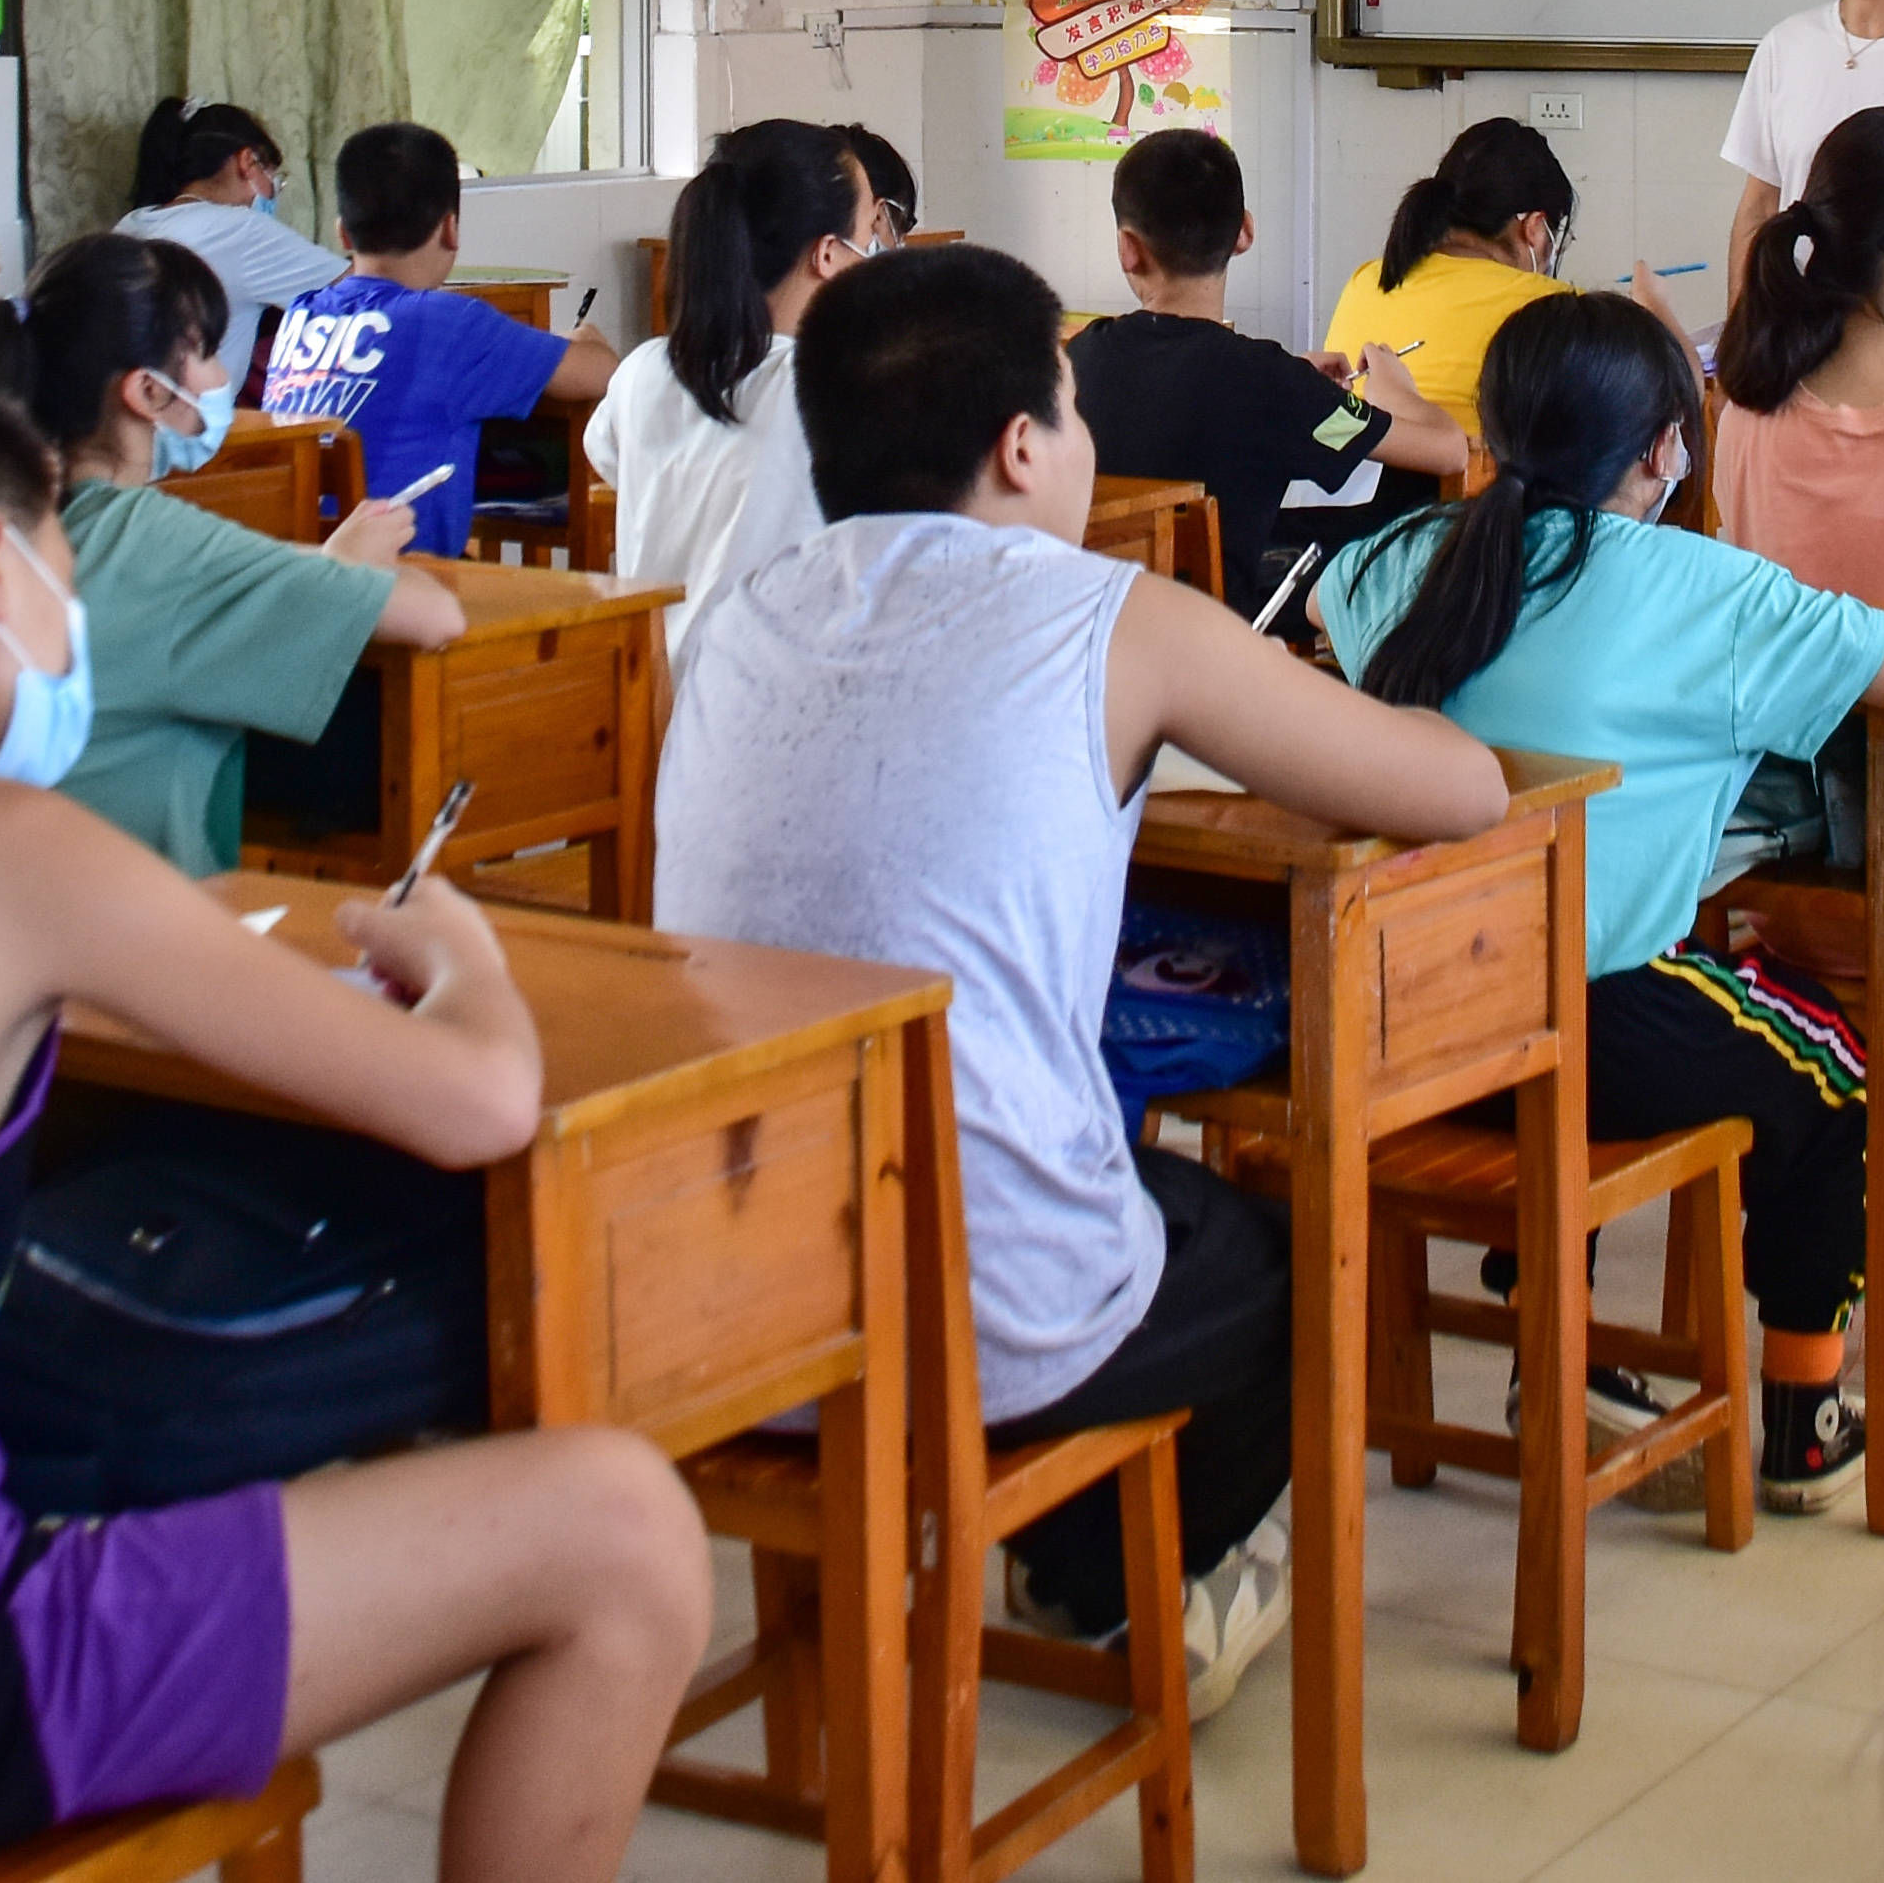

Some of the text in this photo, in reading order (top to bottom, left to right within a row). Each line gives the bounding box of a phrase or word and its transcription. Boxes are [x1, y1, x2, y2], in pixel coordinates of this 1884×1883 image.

[1084, 23, 1165, 71] 学习给力点
